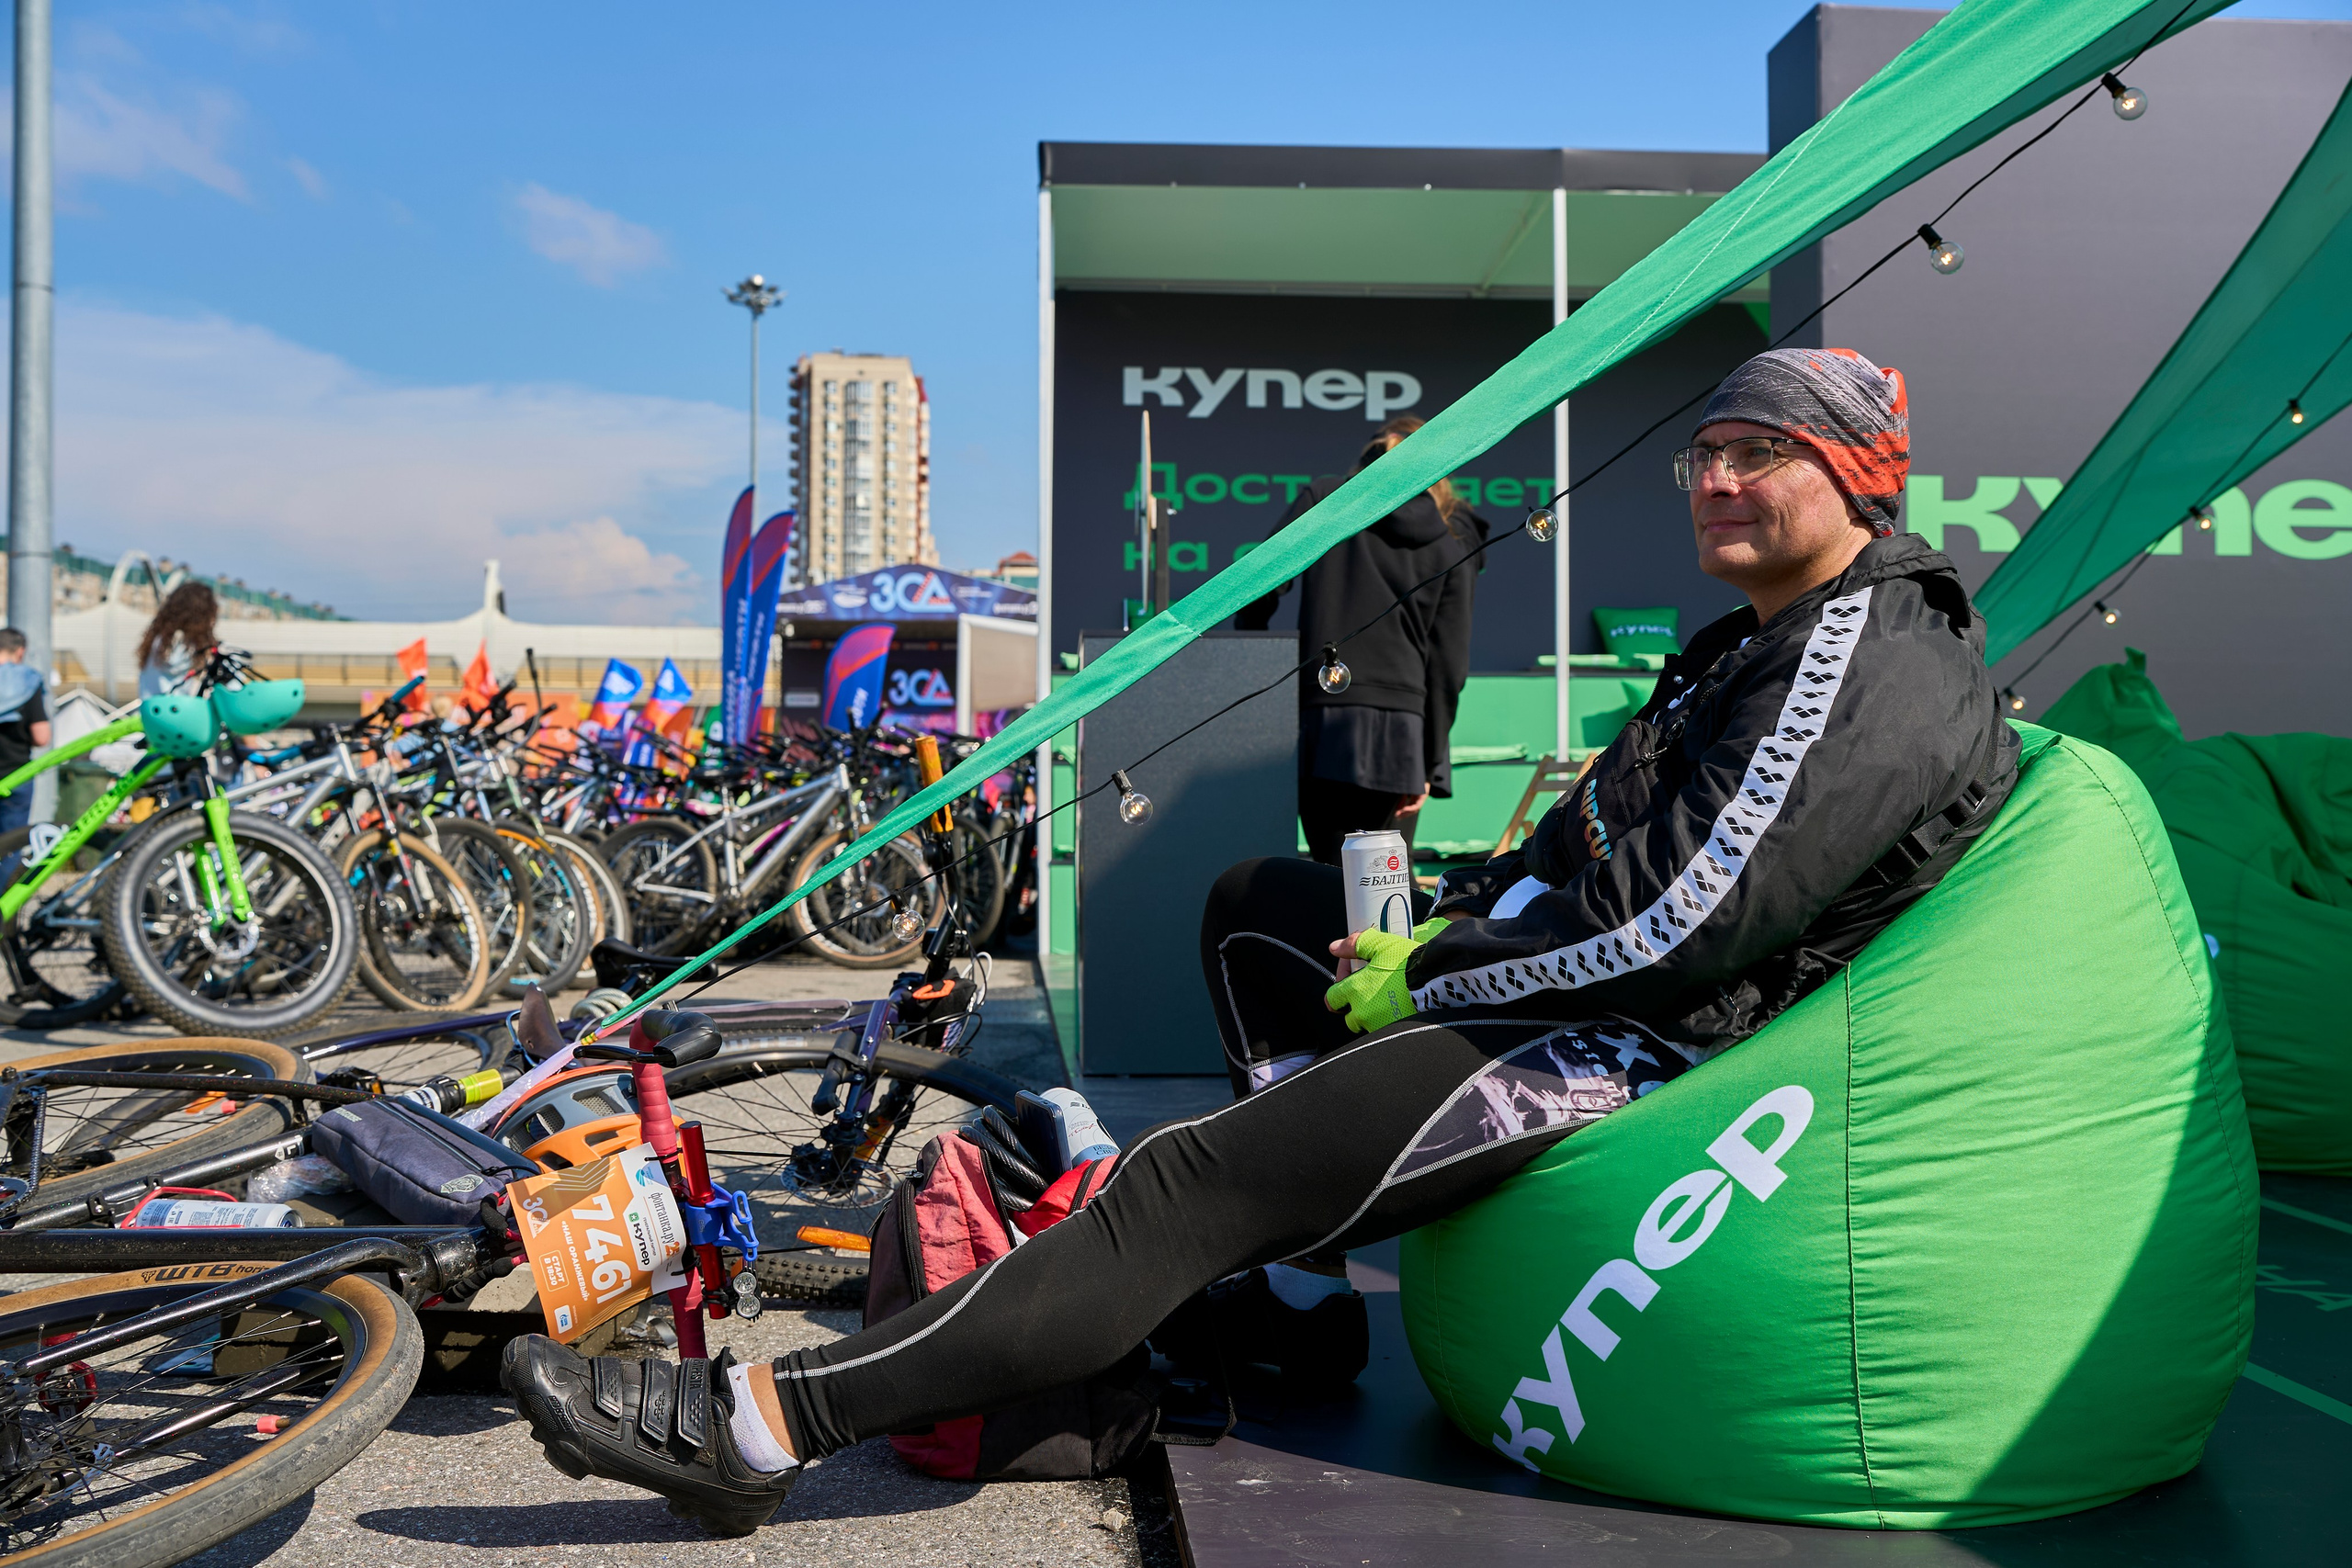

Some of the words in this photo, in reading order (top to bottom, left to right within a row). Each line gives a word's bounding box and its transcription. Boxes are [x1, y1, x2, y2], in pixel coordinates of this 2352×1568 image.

[1123, 366, 1422, 421] купер
[1124, 462, 1555, 511] Достяет
[544, 1257, 551, 1265] В
[561, 1220, 574, 1245] «НАШ
[569, 1246, 591, 1302] ОРАНЖЕВЫЙ»
[571, 1193, 633, 1304] 7461
[633, 1223, 650, 1266] купер
[154, 1263, 237, 1281] WTB
[546, 1265, 558, 1286] 18:30
[551, 1255, 565, 1283] СТАРТ
[1491, 1085, 1815, 1473] купер
